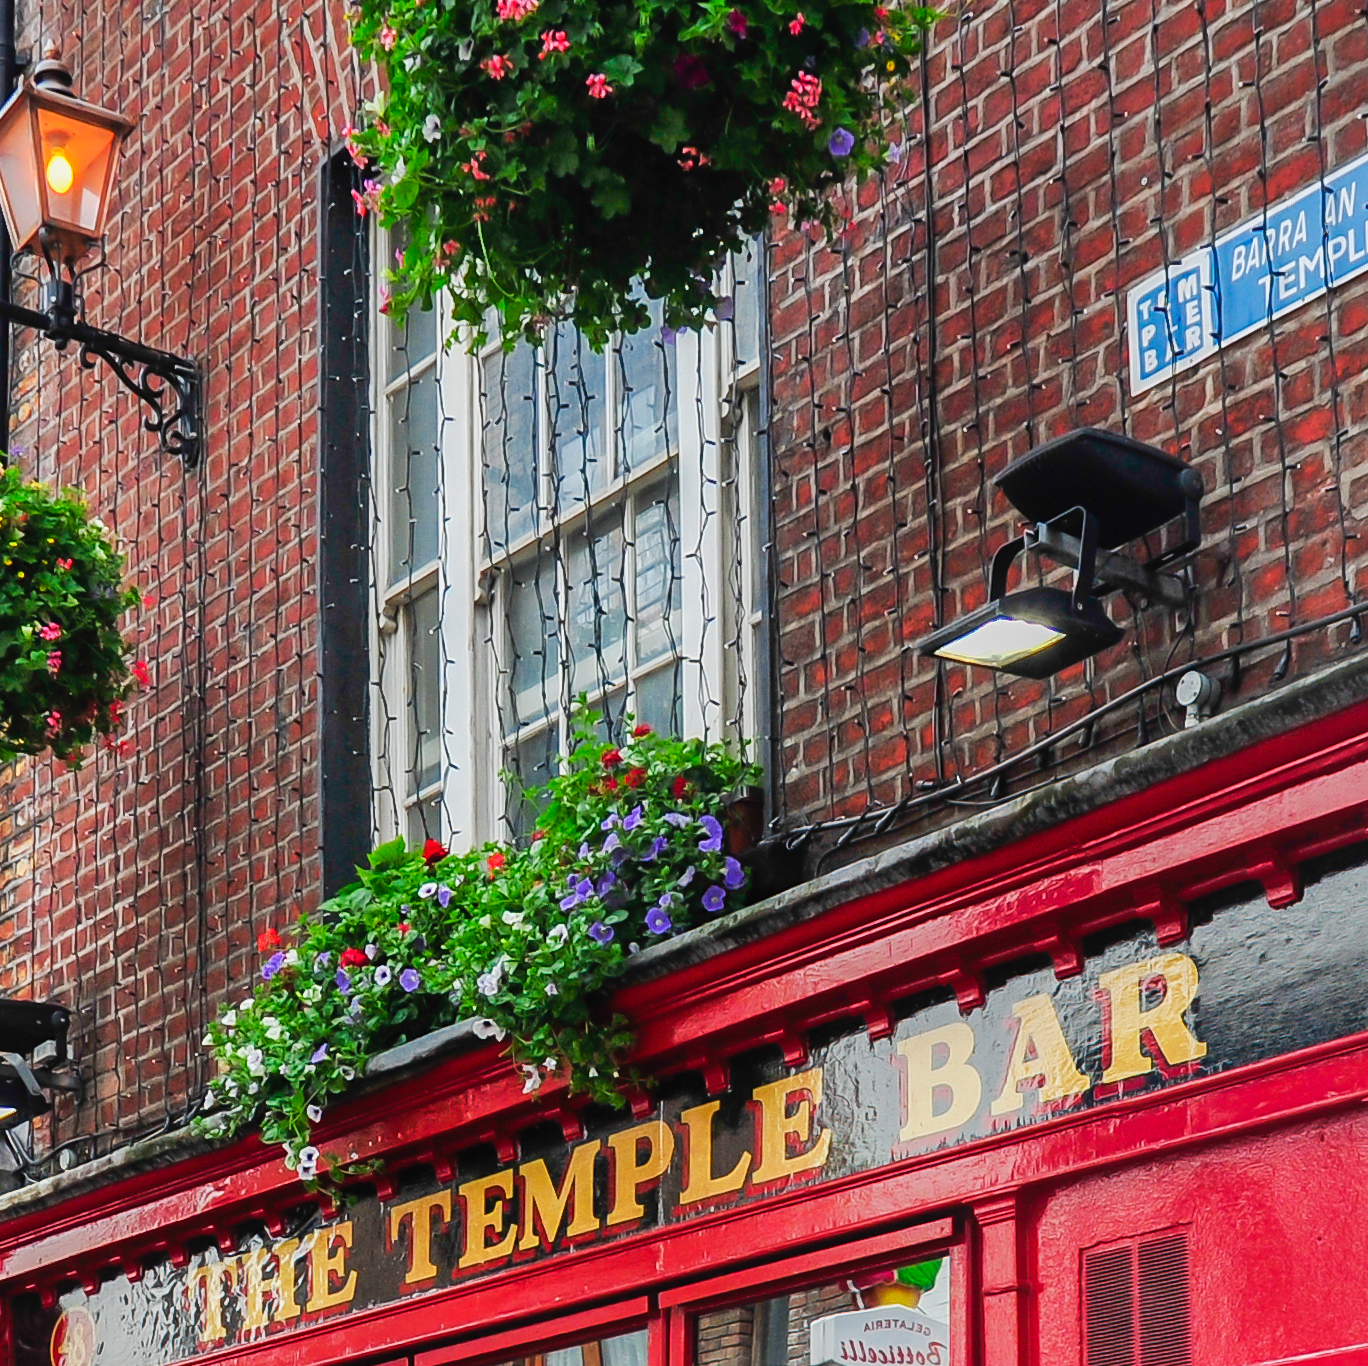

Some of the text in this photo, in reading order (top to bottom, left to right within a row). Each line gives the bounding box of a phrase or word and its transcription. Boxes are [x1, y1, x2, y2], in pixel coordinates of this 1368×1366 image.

[1232, 180, 1356, 282] BARRA AN
[189, 952, 1209, 1346] THE TEMPLE BAR
